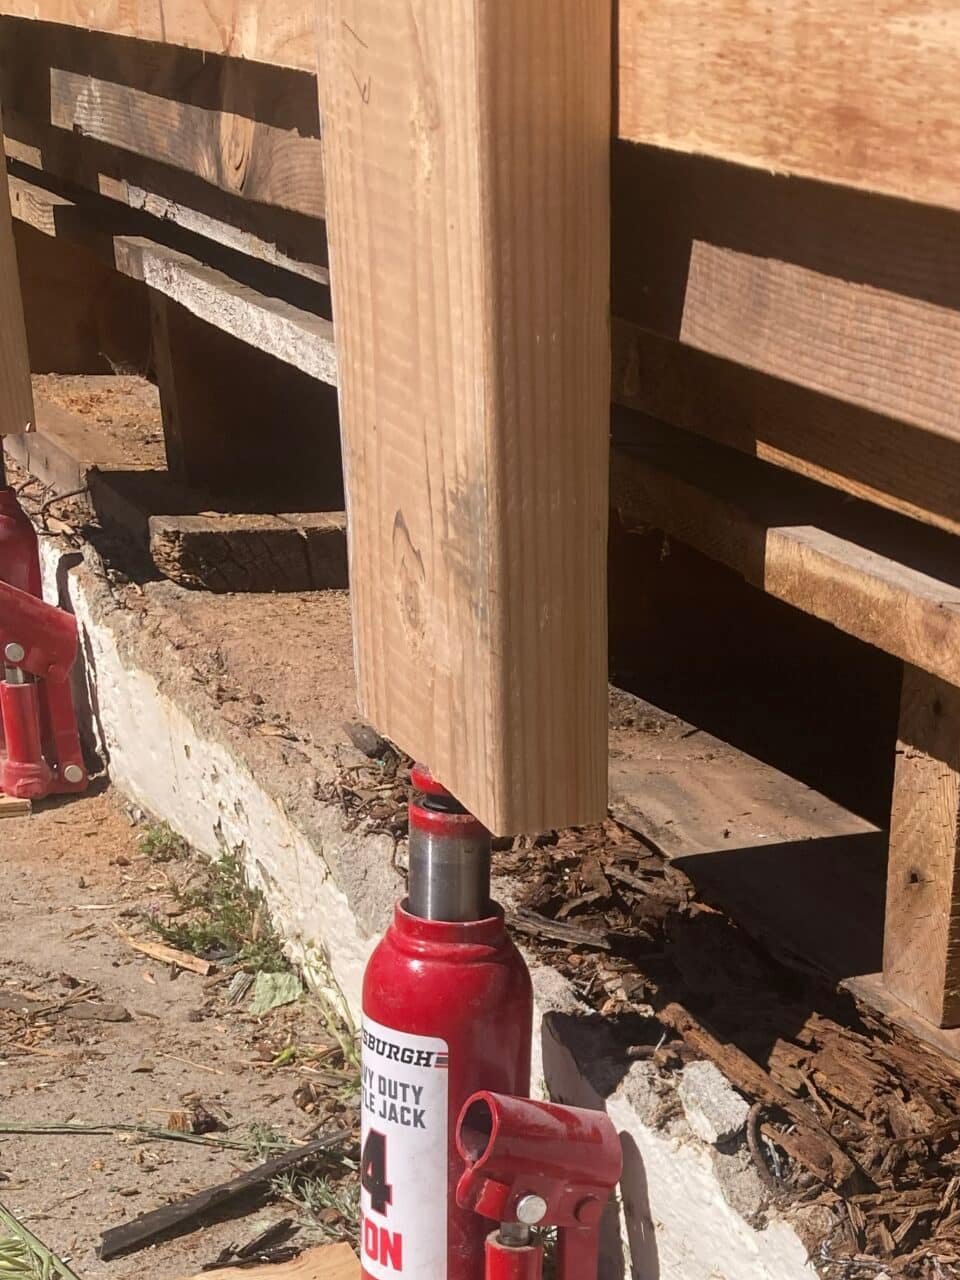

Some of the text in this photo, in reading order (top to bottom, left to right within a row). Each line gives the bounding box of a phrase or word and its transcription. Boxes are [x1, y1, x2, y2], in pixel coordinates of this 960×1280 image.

[378, 1074, 424, 1106] DUTY
[378, 1100, 426, 1129] JACK
[361, 1127, 393, 1217] 4
[361, 1208, 403, 1272] ON
